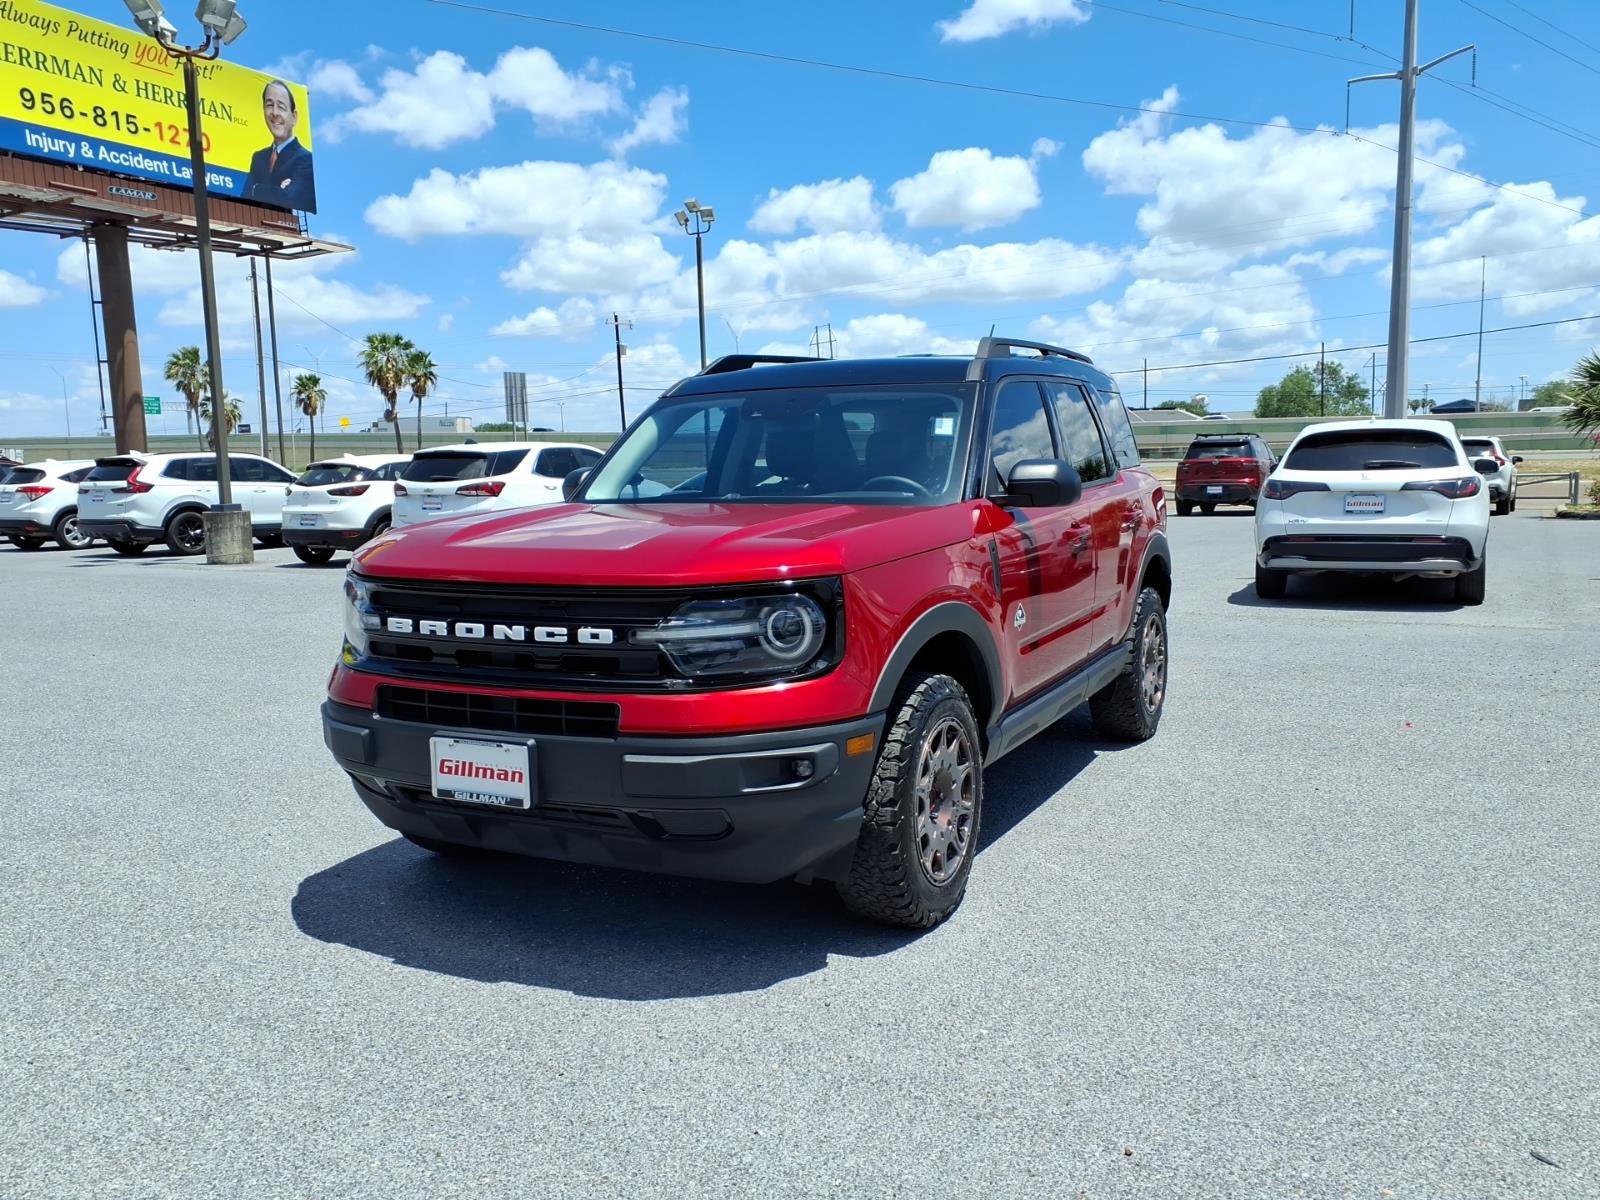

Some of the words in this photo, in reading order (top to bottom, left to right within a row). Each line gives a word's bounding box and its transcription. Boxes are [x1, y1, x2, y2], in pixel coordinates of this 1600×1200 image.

[66, 20, 129, 59] Putting
[135, 42, 169, 66] you
[175, 56, 223, 80] Fst!"
[0, 42, 103, 88] ERRMAN
[112, 73, 128, 94] &
[25, 129, 75, 158] Injury
[80, 141, 95, 159] &
[98, 145, 170, 175] Accident
[172, 161, 234, 188] Layers
[111, 187, 153, 200] LAMAR
[387, 617, 613, 644] BRONCO
[439, 758, 524, 784] Gillman
[454, 791, 507, 805] GILLMAN
